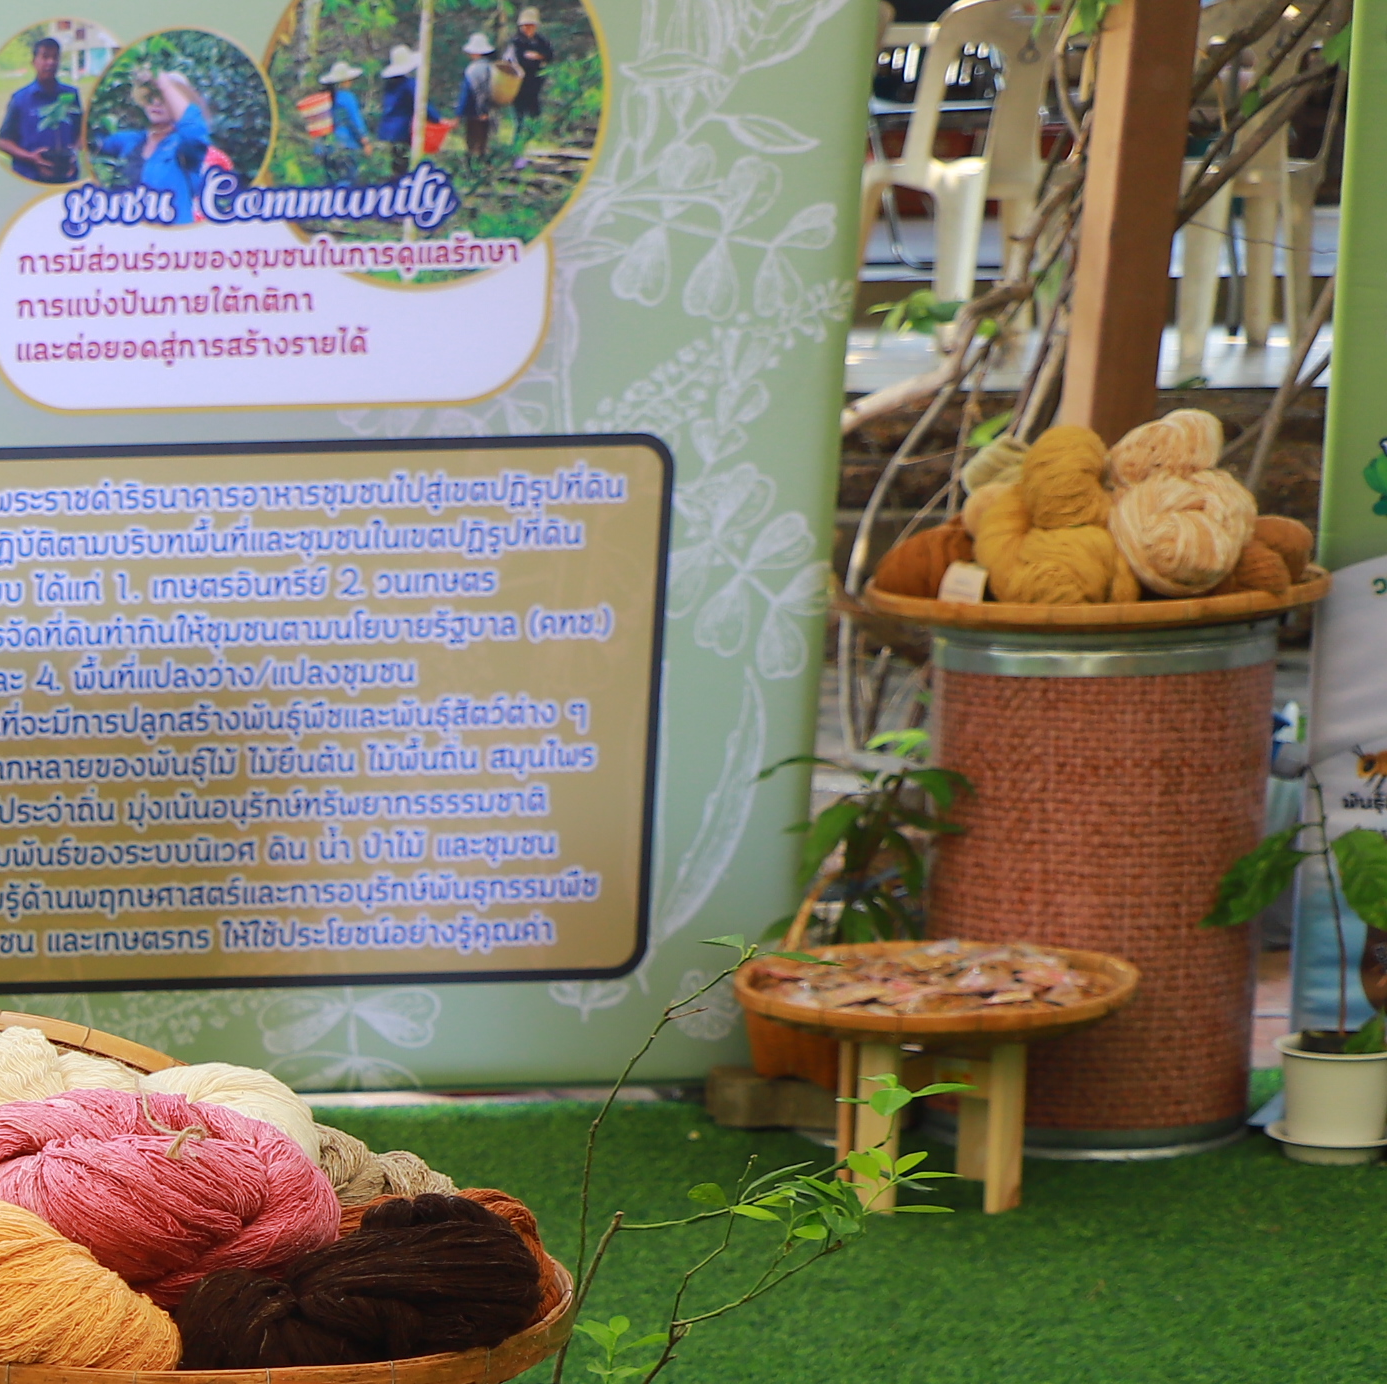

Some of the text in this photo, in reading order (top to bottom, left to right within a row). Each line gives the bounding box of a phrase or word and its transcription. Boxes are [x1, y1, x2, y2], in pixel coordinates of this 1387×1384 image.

[62, 164, 456, 238] ชุมชน Community
[18, 236, 520, 278] การมีส่วนร่วมของชุมชนในการดูแลรักษา
[17, 285, 314, 319] การแบ่งปันภายใต้กติกา
[16, 326, 370, 366] และต่อยอดสู่การสร้างรายได้
[34, 571, 103, 603] ได้แก่
[115, 573, 142, 602] 1.
[151, 565, 328, 602] เกษตรอินทรีย์
[338, 567, 365, 596] 2.
[374, 568, 497, 597] วนเกษตร
[529, 603, 615, 639] (คทช.)
[34, 664, 62, 693] 4.
[74, 653, 417, 695] พื้นที่แปลงว่าง/แปลงชุมชน
[248, 744, 356, 775] ไม้ยืนต้น
[366, 735, 479, 773] ไม้พื้นถิ่น
[487, 739, 598, 778] สมุนไพร
[267, 837, 308, 862] ดิน
[318, 826, 353, 860] น้ำ
[363, 829, 425, 860] ป่าไม้
[436, 831, 558, 867] และชุมชน
[46, 924, 212, 955] และเกษตรกร
[221, 912, 555, 953] ให้ใช้ประโยชน์อย่างรู้คุณค่า
